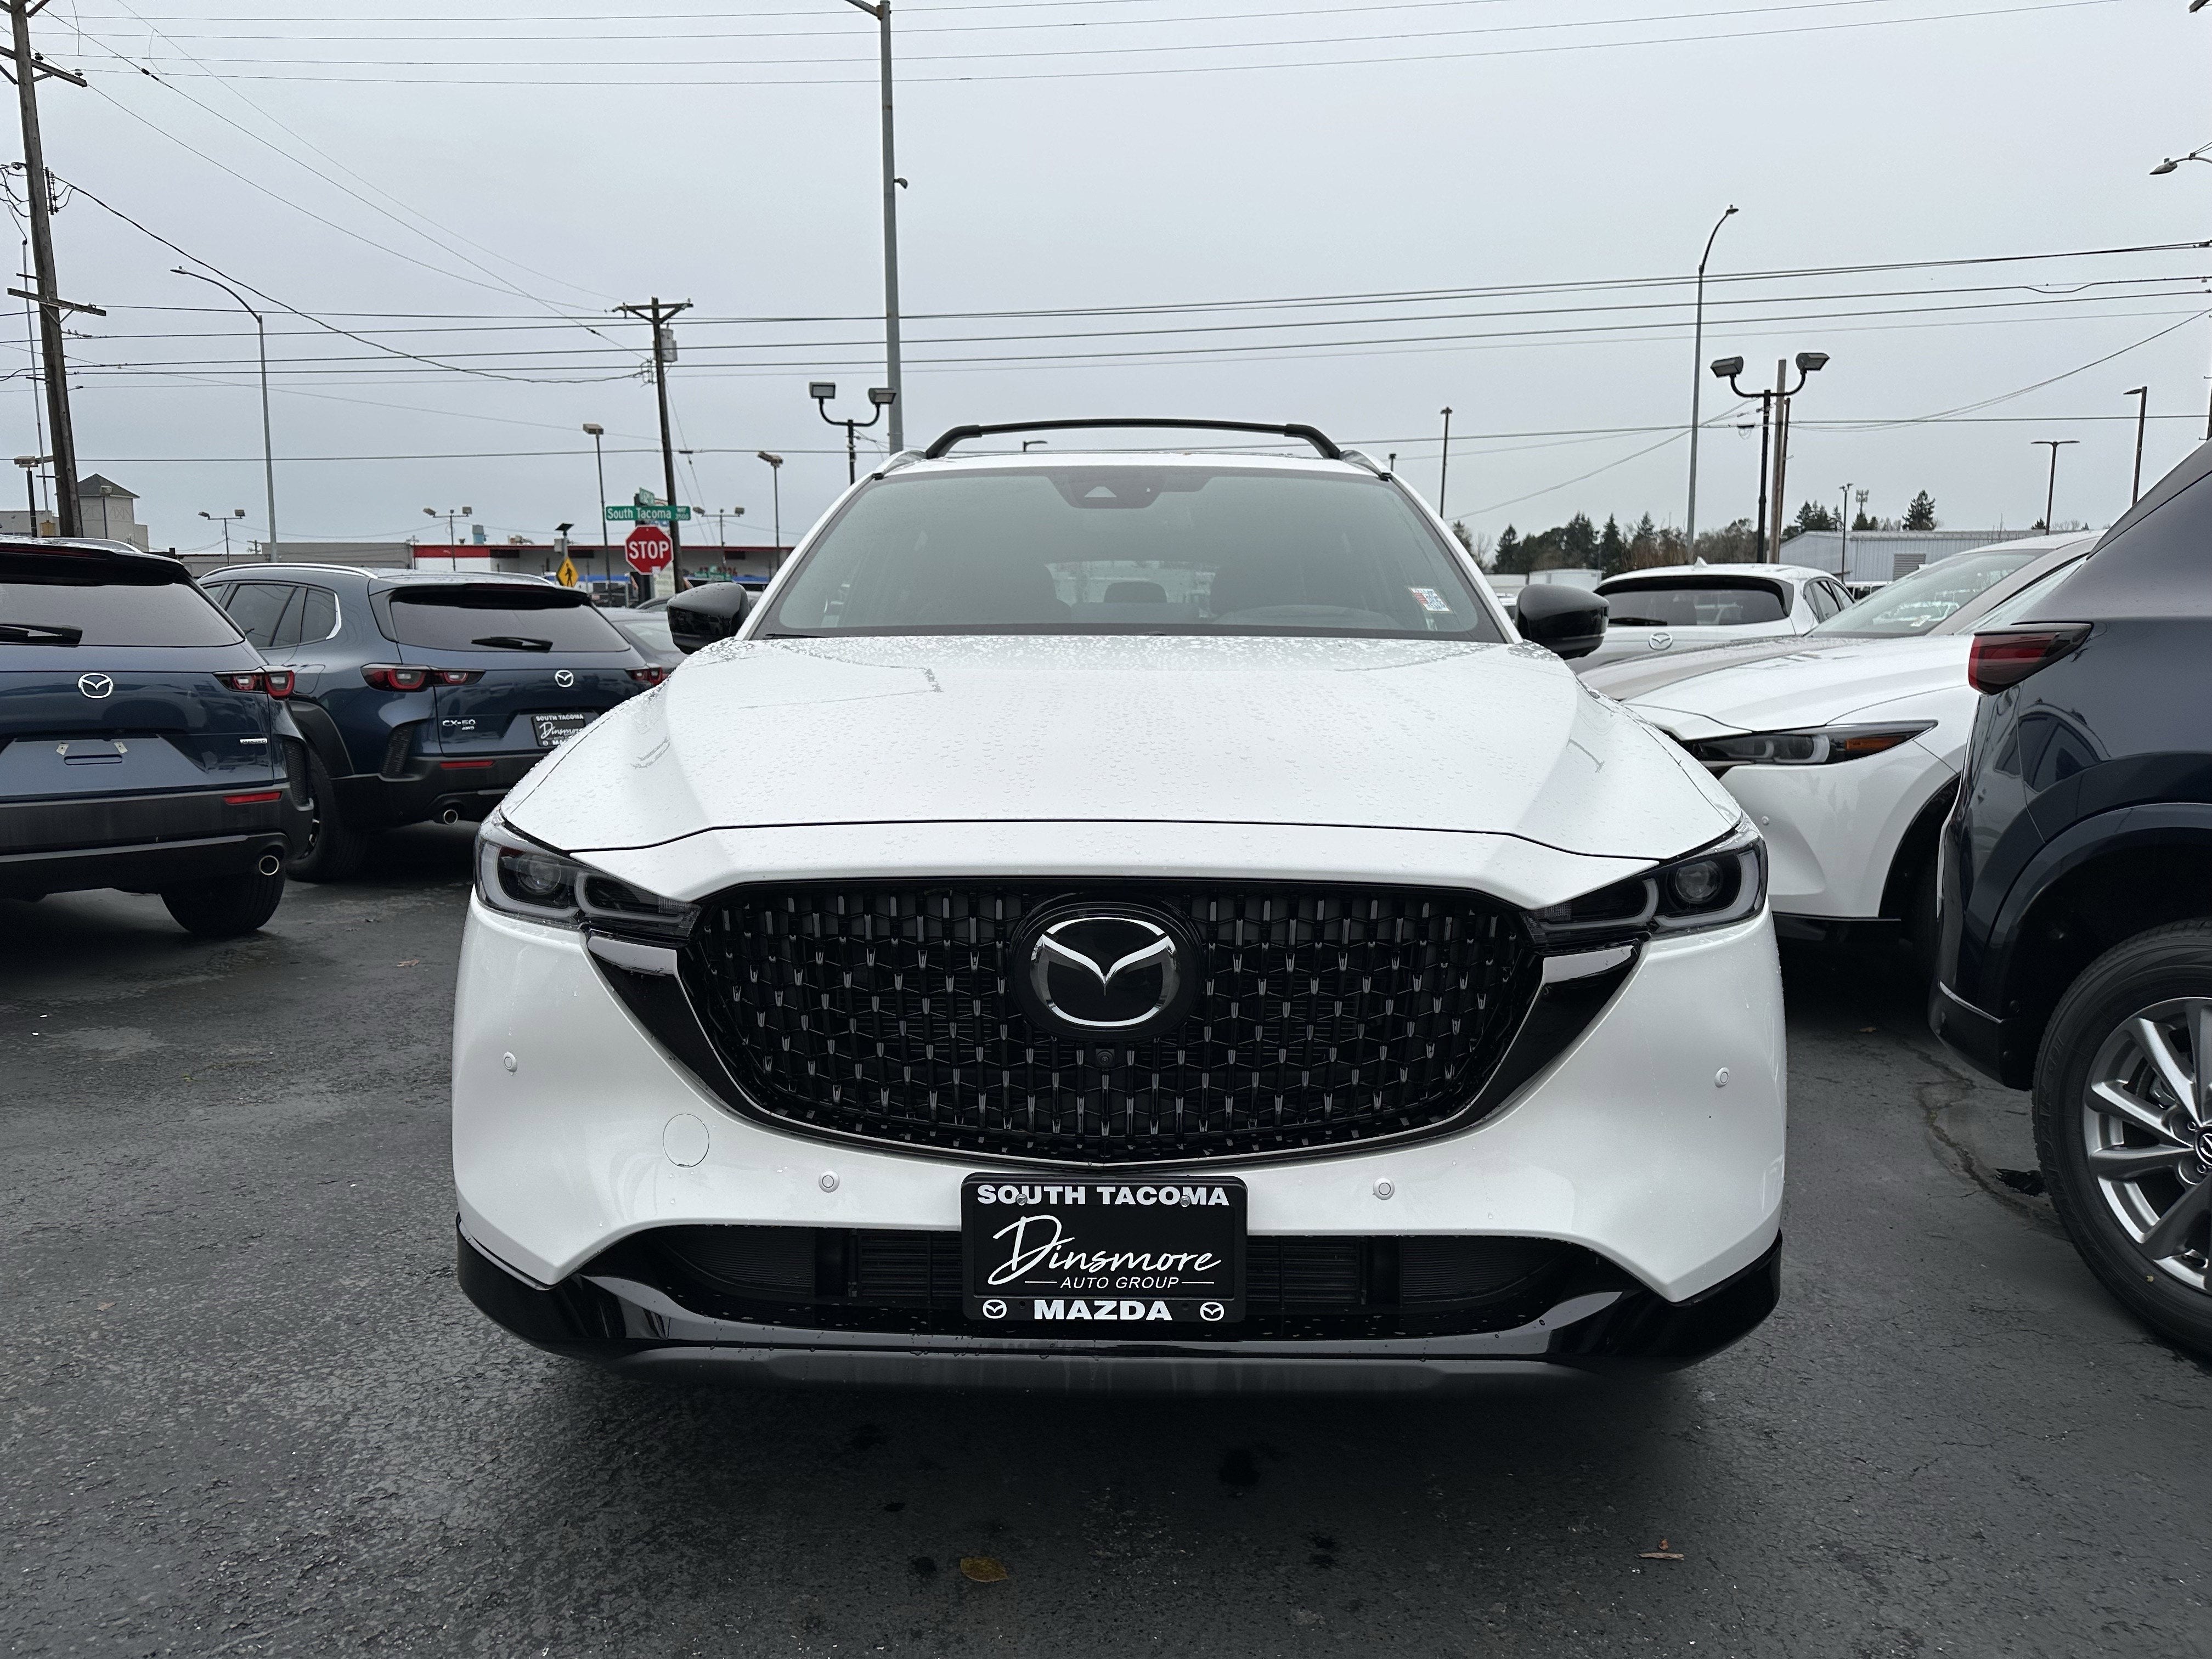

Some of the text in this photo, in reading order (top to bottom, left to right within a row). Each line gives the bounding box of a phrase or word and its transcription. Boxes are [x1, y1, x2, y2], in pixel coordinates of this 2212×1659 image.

[607, 508, 633, 519] South
[636, 507, 672, 519] Tacoma
[629, 541, 669, 560] STOP
[977, 1184, 1229, 1206] SOUTH TACOMA
[987, 1215, 1221, 1285] Dinsmore
[1060, 1277, 1179, 1289] AUTO GROUP
[1034, 1299, 1173, 1321] MAZDA
